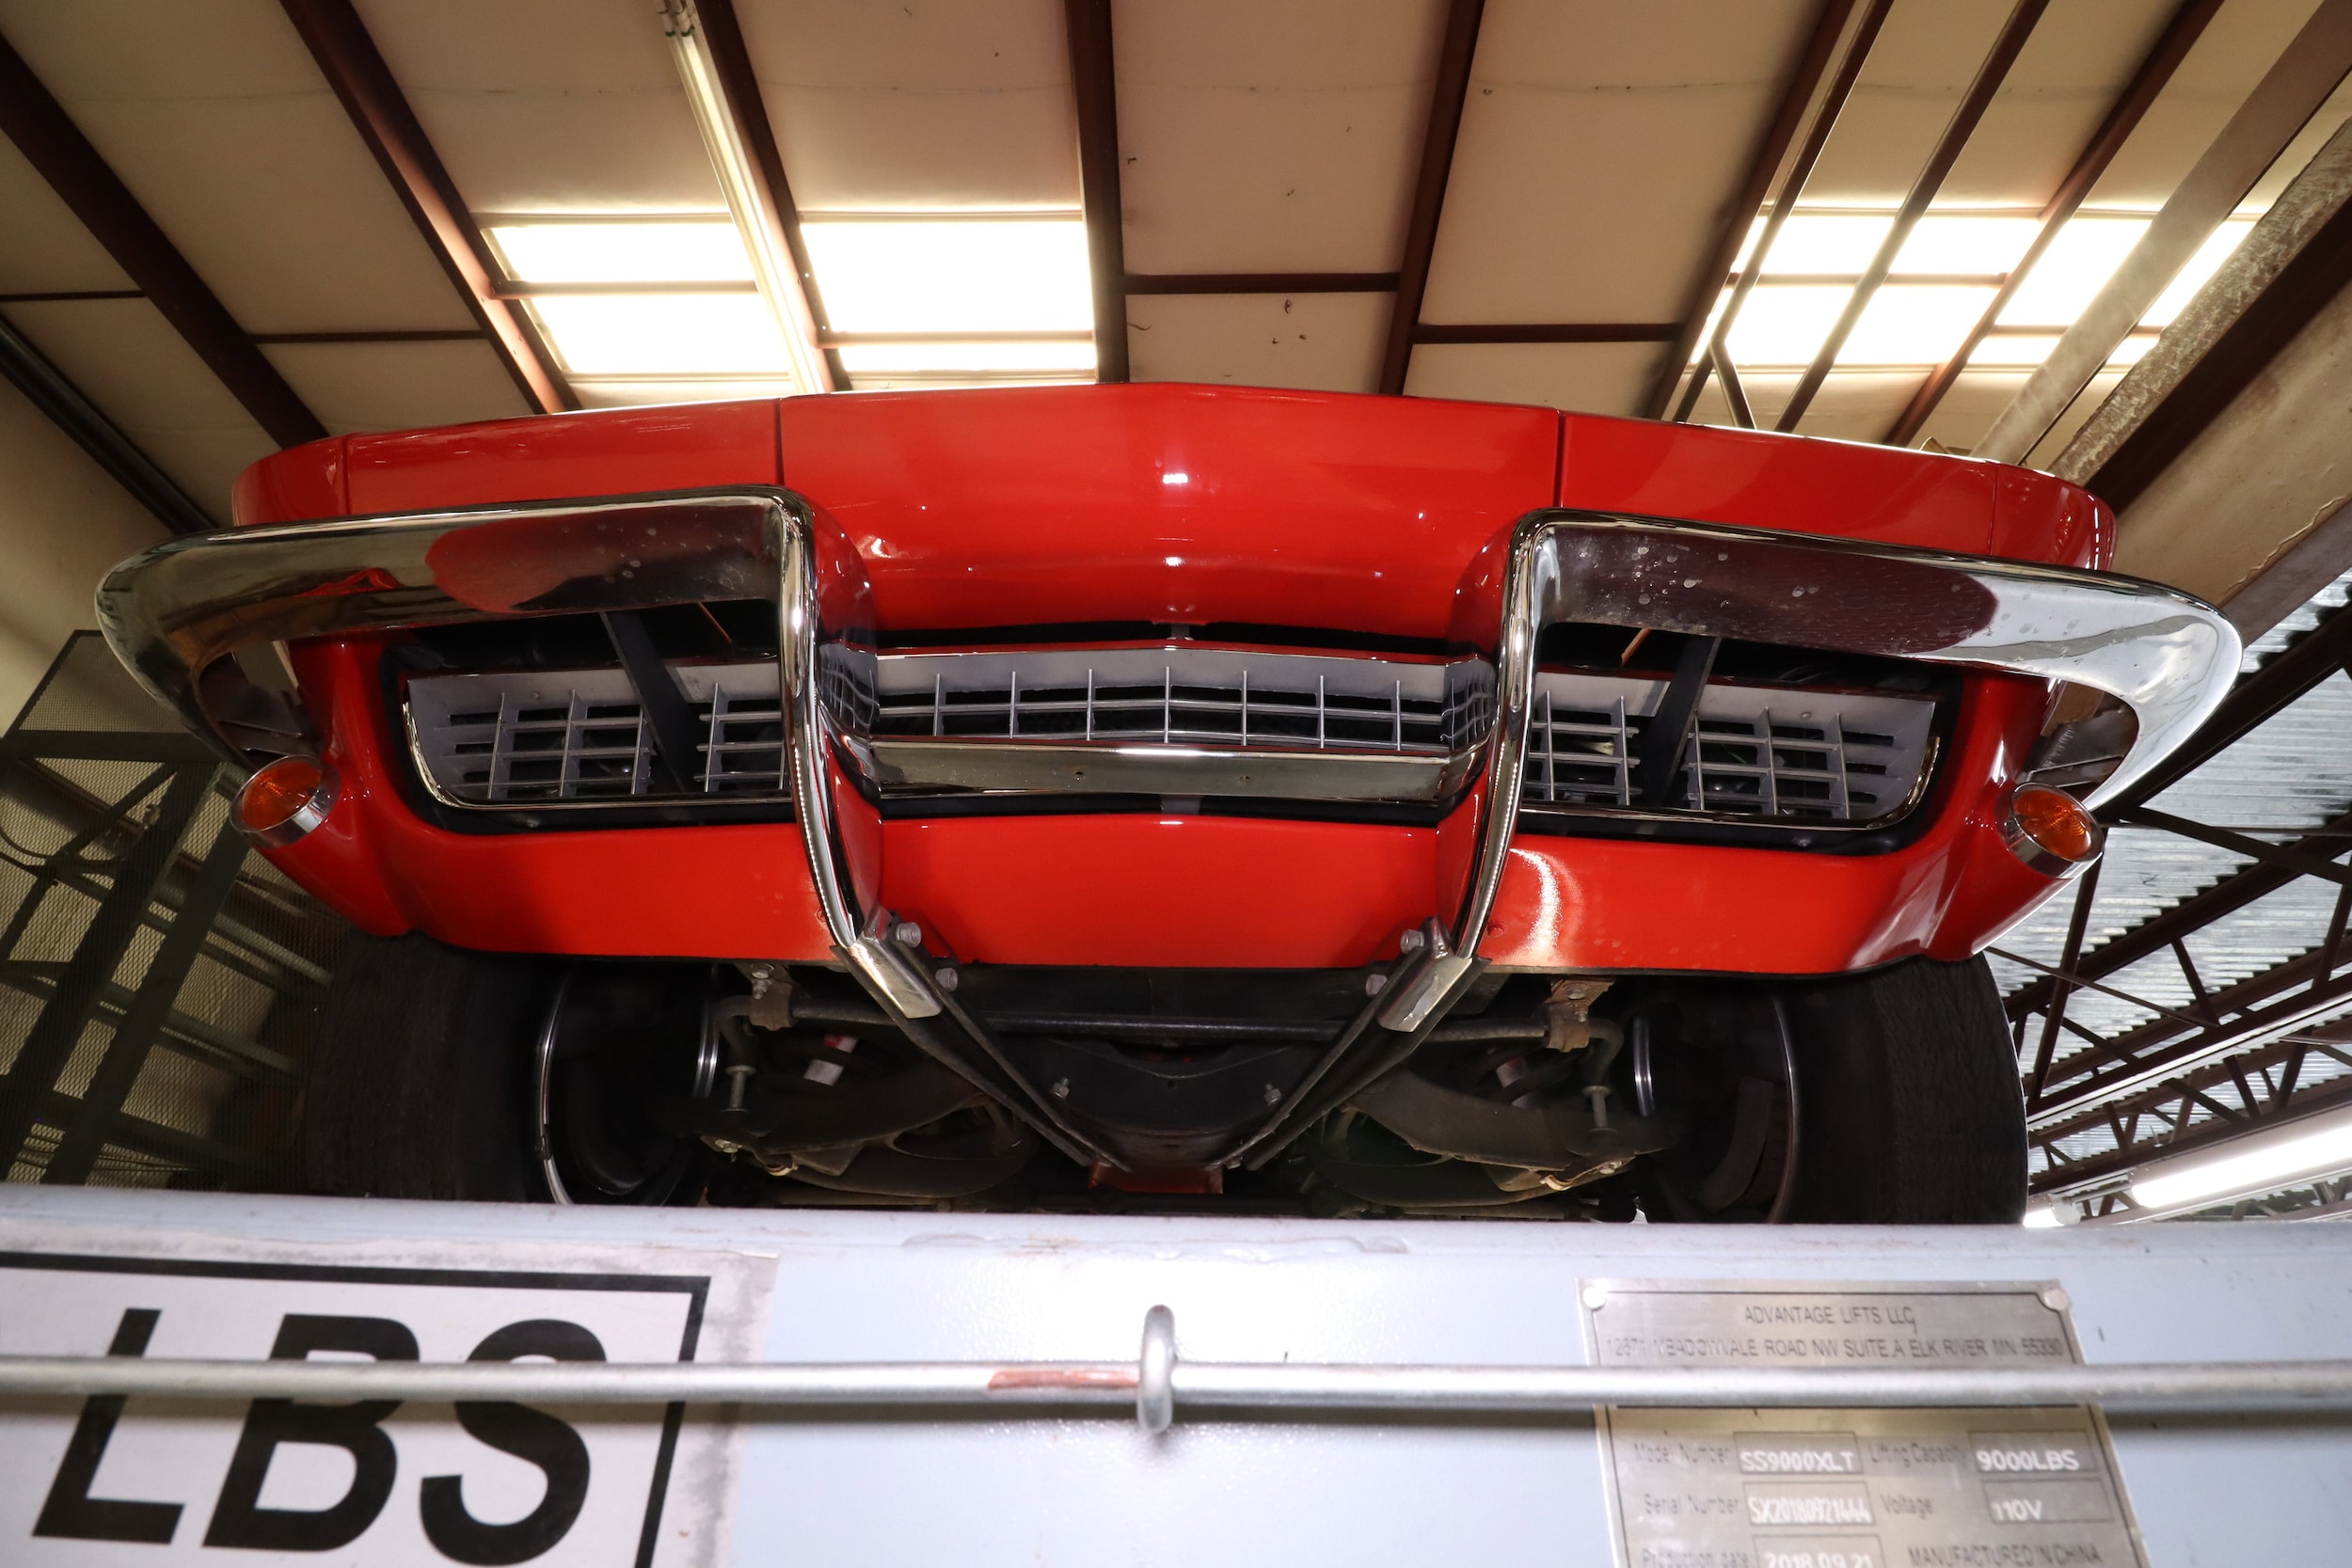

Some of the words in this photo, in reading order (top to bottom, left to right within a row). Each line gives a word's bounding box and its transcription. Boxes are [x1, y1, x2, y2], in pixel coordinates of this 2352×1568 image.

[1744, 1307, 1836, 1324] ADVANTAGE
[1839, 1307, 1882, 1324] LIFTS
[1765, 1338, 1807, 1357] ROAD
[1812, 1338, 1839, 1357] NW
[1844, 1338, 1888, 1358] SUITE
[1909, 1338, 1941, 1358] ELK
[1943, 1338, 1988, 1358] RIVER
[31, 1308, 608, 1566] LBS
[1677, 1442, 1729, 1464] Number
[1740, 1449, 1854, 1472] SS9000XLT
[1976, 1449, 2080, 1471] 9000LBS
[1643, 1493, 1682, 1515] Serial
[1687, 1493, 1740, 1515] Number
[1880, 1493, 1933, 1520] Voltage
[1990, 1498, 2043, 1521] 110V
[1907, 1543, 2035, 1568] MANUFACTURED
